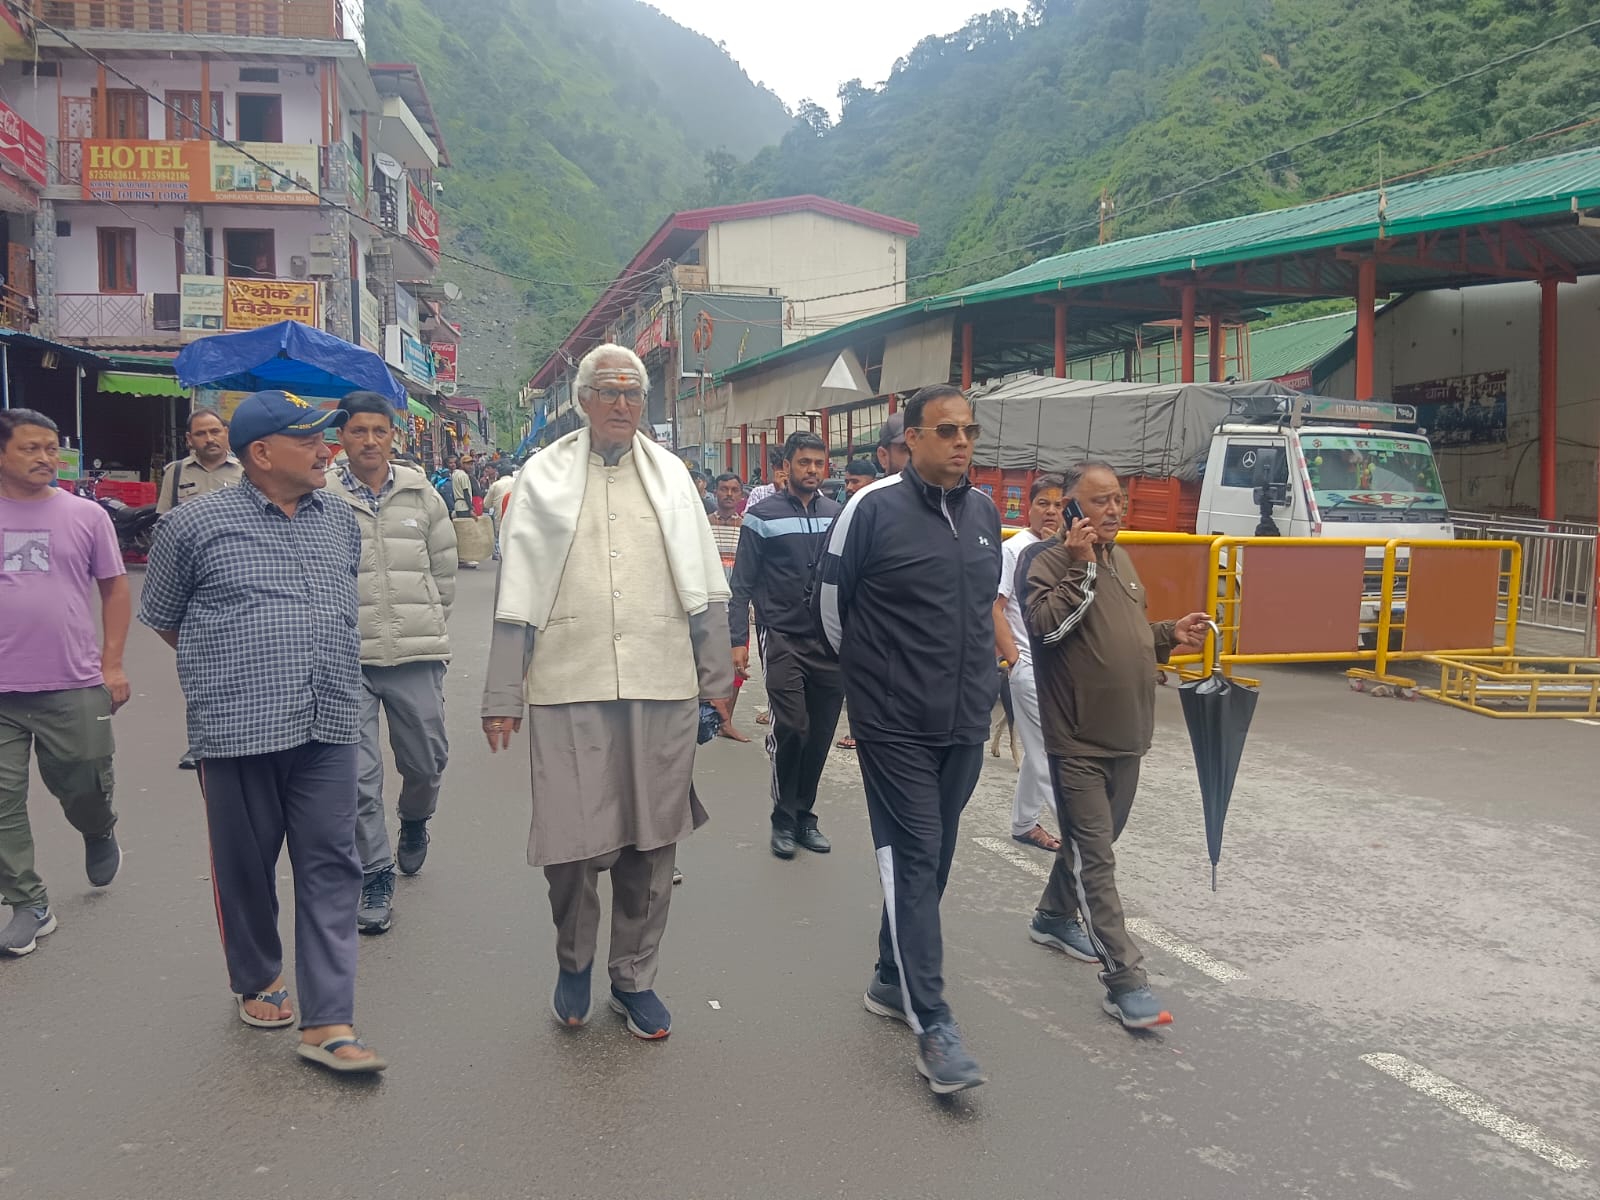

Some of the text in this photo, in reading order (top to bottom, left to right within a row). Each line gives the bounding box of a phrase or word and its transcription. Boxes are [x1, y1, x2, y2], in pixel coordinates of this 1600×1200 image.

[89, 145, 189, 169] HOTEL
[118, 190, 155, 200] TOURIST
[158, 191, 189, 201] LODGE
[250, 284, 293, 300] थोक
